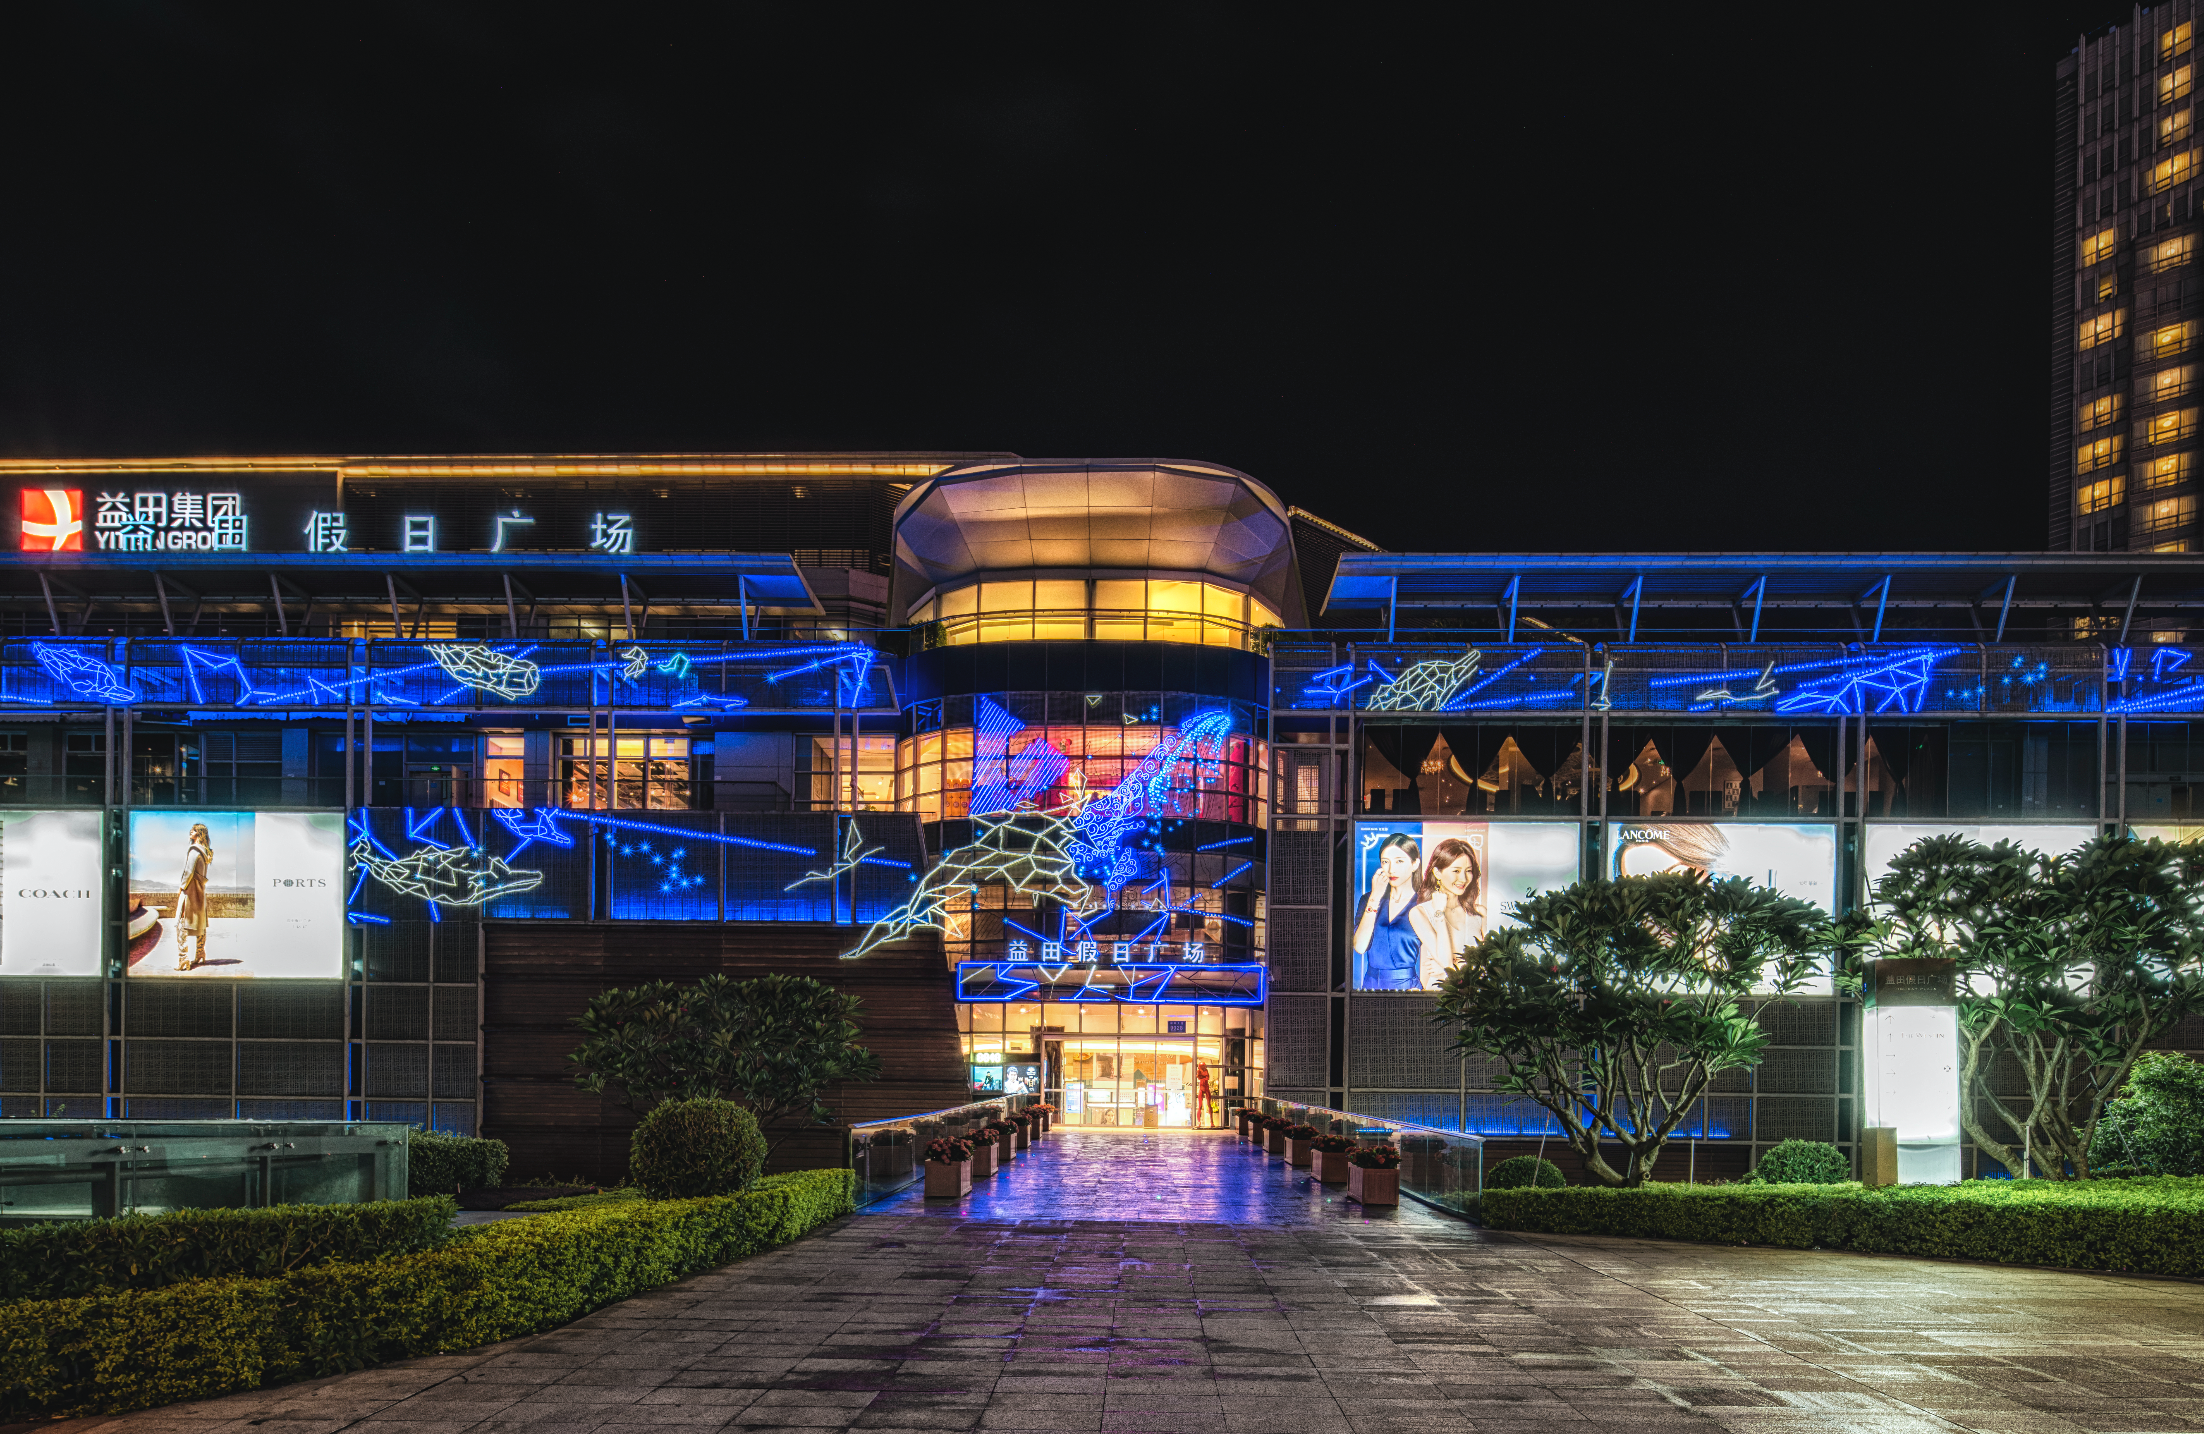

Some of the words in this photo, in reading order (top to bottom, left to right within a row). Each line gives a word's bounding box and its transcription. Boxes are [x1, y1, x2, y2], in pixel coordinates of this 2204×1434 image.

[96, 491, 242, 528] 益田集团
[1616, 828, 1670, 840] LANCÔME
[272, 878, 327, 888] PORTS
[18, 888, 91, 899] COACH
[1007, 940, 1205, 964] 益田假日广场
[1884, 974, 1949, 985] 益田假日广场
